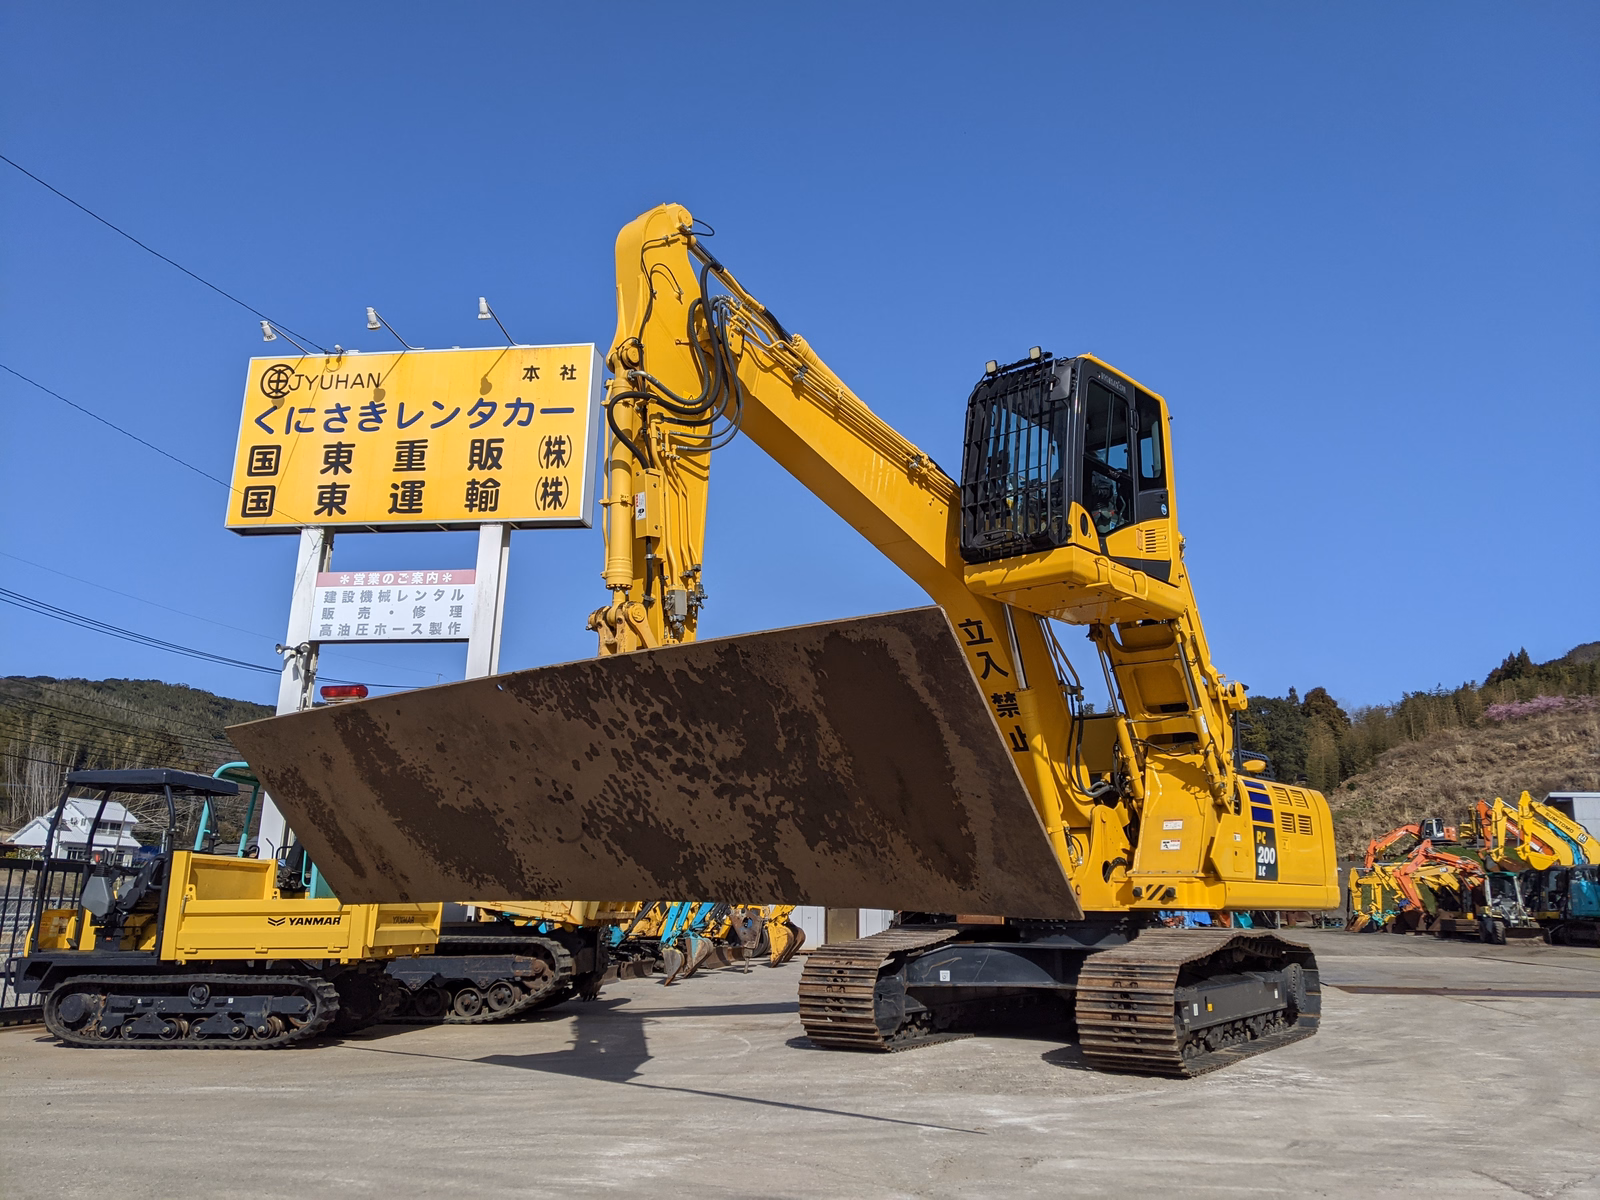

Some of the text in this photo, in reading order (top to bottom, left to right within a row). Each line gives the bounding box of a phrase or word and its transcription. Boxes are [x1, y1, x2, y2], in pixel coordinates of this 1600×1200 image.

[288, 372, 381, 391] JYUHAN
[522, 364, 578, 383] 本社
[254, 397, 575, 435] くにさきレンタカー
[323, 588, 465, 604] 建設機械レンタル
[319, 621, 462, 637] 高油圧ホース製作
[1256, 830, 1267, 845] PC
[1257, 845, 1276, 865] 200
[289, 917, 341, 926] YANMAR
